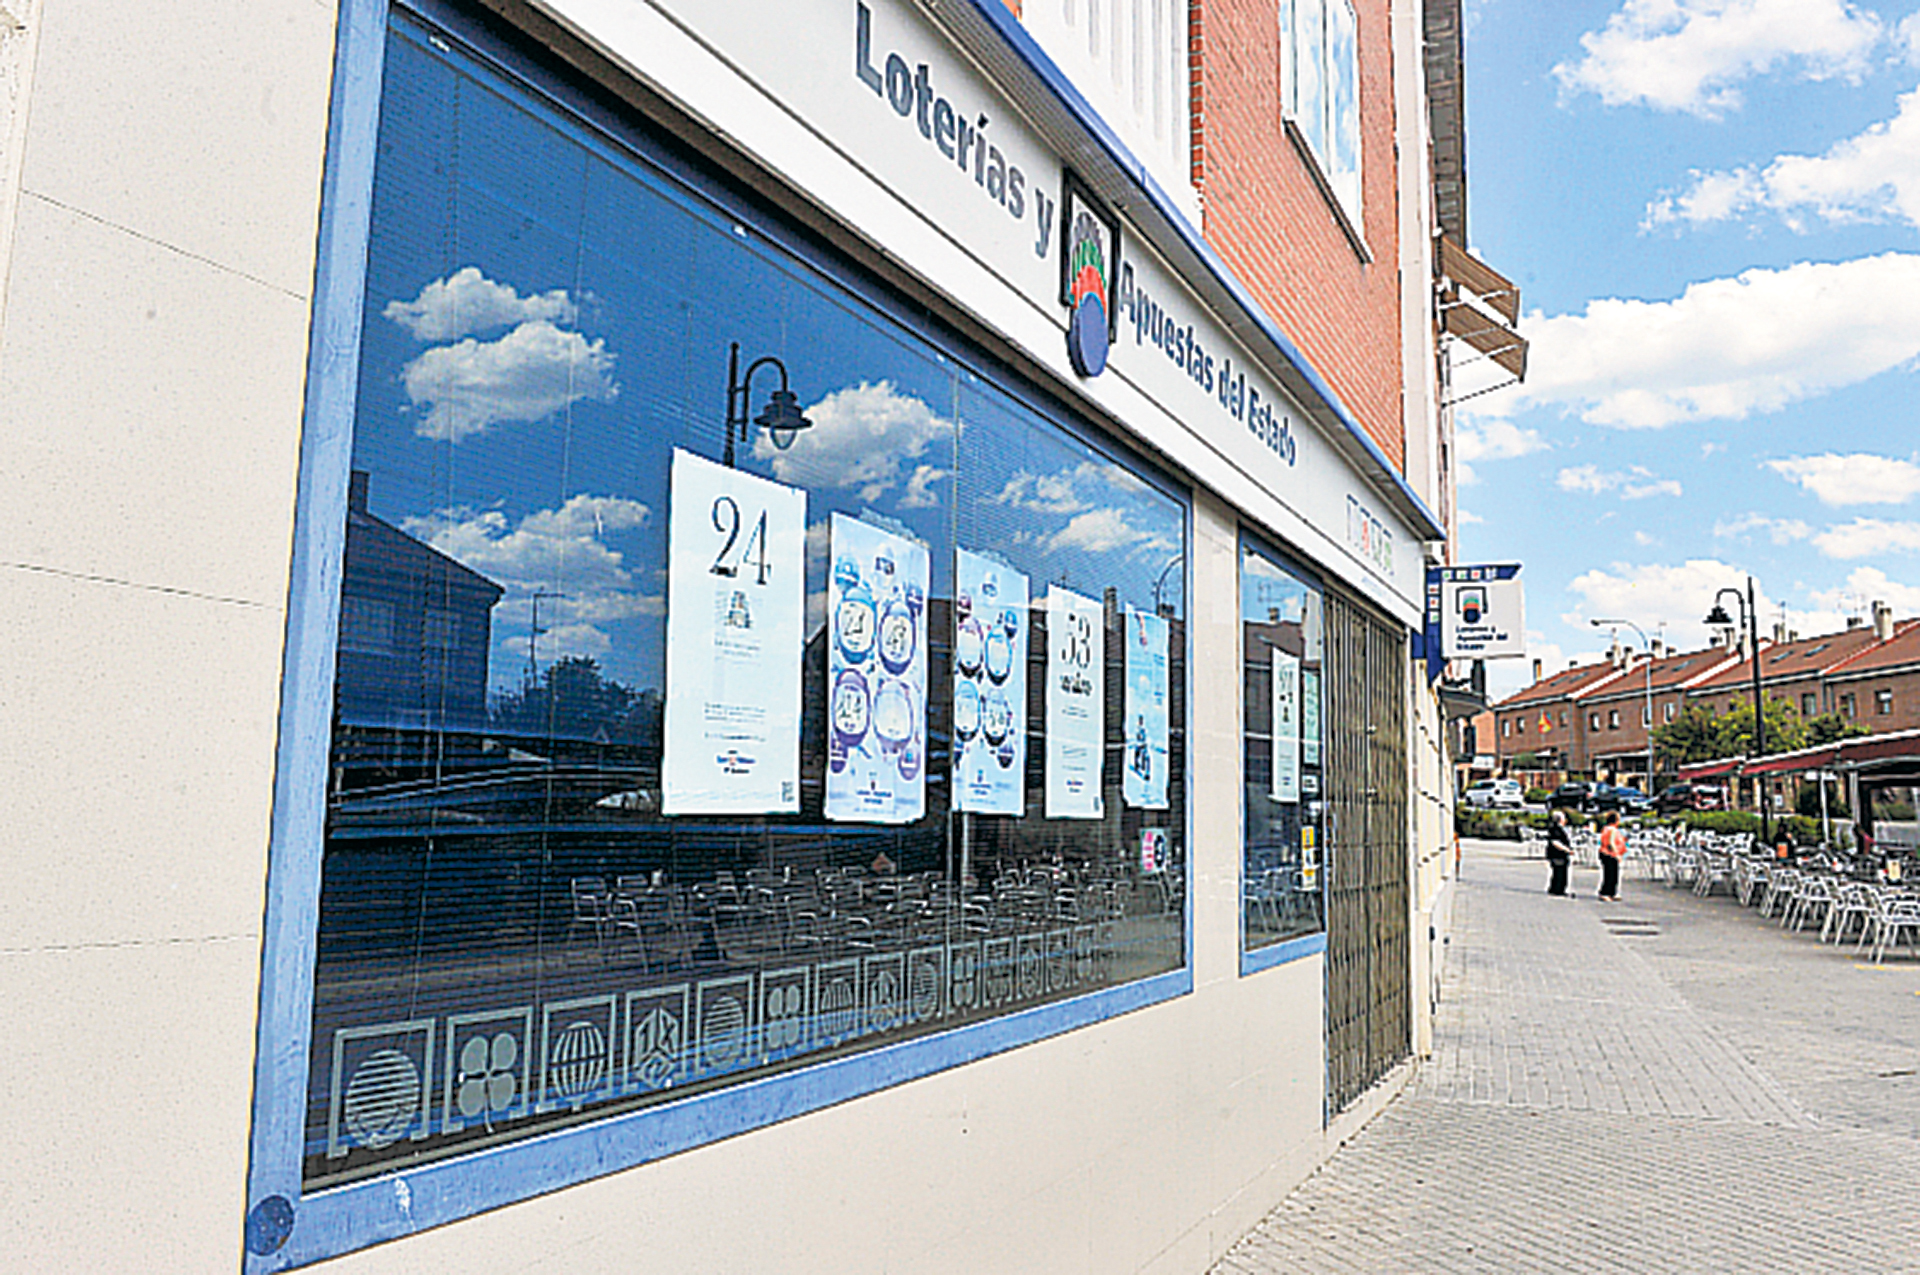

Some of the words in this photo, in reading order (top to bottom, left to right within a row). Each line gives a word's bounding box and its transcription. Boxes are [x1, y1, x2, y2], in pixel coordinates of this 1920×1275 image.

[856, 0, 1025, 219] Loterías
[1034, 187, 1054, 259] y
[1119, 261, 1213, 394] Apuestas
[1218, 358, 1245, 422] del
[1248, 386, 1297, 467] Estado
[709, 495, 771, 586] 24
